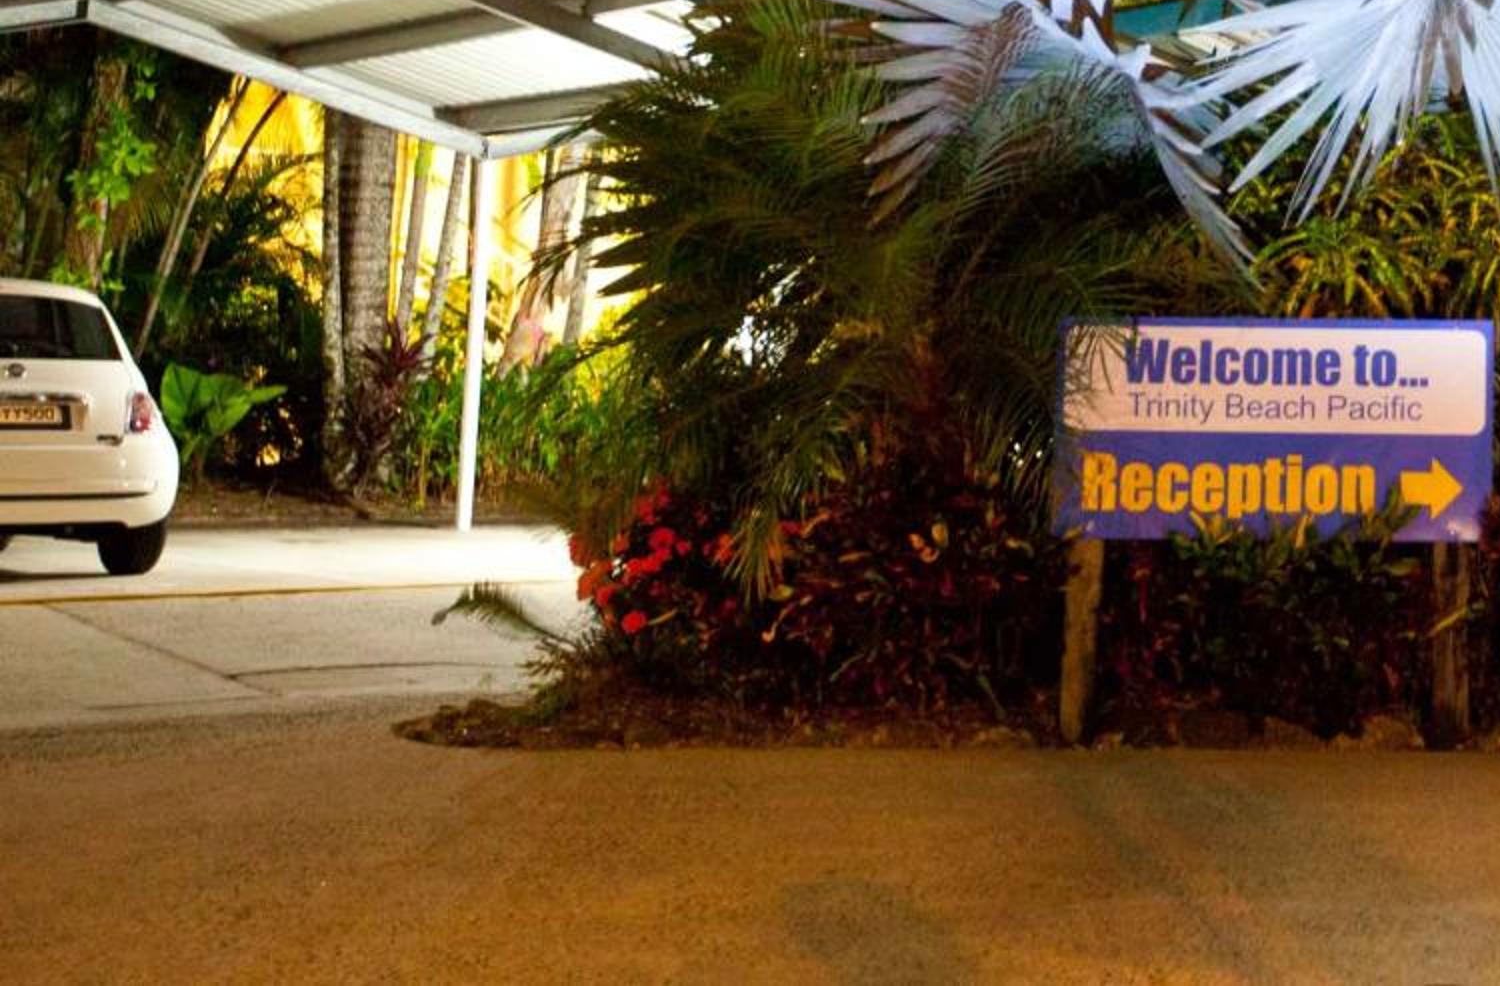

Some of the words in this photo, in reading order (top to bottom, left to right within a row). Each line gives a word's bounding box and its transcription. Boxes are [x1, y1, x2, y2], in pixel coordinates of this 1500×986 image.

[1124, 338, 1341, 386] Welcome
[1353, 344, 1429, 387] to...
[1129, 391, 1214, 424] Trinity
[1225, 392, 1315, 420] Beach
[1327, 395, 1423, 421] Pacific
[1081, 452, 1376, 518] Reception
